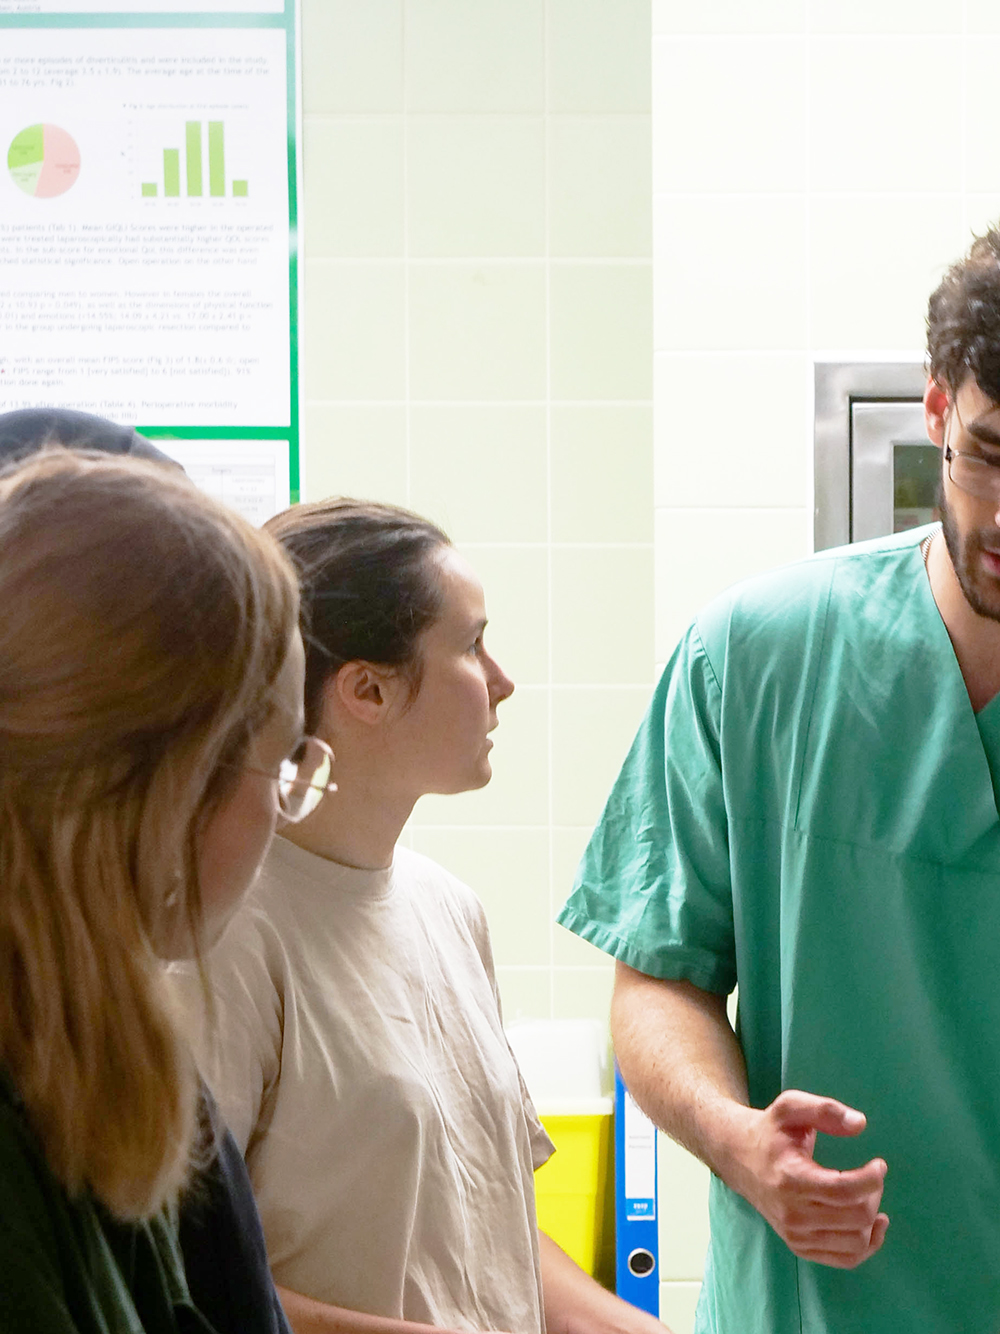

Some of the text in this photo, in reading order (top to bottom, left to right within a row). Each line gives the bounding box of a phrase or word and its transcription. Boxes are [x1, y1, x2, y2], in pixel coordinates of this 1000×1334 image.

[38, 56, 72, 65] episodes
[86, 56, 138, 64] diverticulitis
[140, 56, 156, 64] and
[180, 56, 216, 64] included
[228, 56, 242, 64] the
[244, 56, 268, 65] study.
[43, 67, 79, 76] (average
[127, 67, 142, 75] The
[144, 68, 177, 76] average
[179, 68, 194, 76] age
[207, 67, 221, 75] the
[223, 67, 243, 75] time
[255, 67, 270, 75] the
[12, 224, 45, 232] patients
[48, 224, 65, 232] (Tab
[181, 224, 207, 232] higher
[236, 224, 274, 232] operated
[24, 235, 55, 243] treated
[57, 235, 122, 244] laparoscopically
[125, 235, 140, 243] had
[143, 235, 194, 244] substantially
[196, 235, 222, 244] higher
[25, 246, 40, 254] the
[98, 246, 139, 254] emotional
[159, 246, 174, 254] this
[177, 246, 219, 254] difference
[21, 257, 61, 265] statistical
[118, 257, 140, 266] Open
[142, 257, 182, 266] operation
[196, 257, 210, 265] the
[212, 257, 234, 265] other
[237, 257, 257, 265] hand
[13, 290, 56, 299] comparing
[124, 290, 159, 298] However
[173, 290, 205, 298] females
[207, 290, 221, 298] the
[223, 290, 252, 298] overall
[98, 301, 115, 309] well
[129, 301, 142, 309] the
[145, 301, 190, 309] dimensions
[203, 301, 236, 310] physical
[238, 301, 273, 309] function
[20, 312, 36, 320] and
[38, 312, 76, 320] emotions
[15, 323, 29, 331] the
[31, 324, 55, 332] group
[57, 323, 102, 332] undergoing
[104, 323, 155, 332] laparoscopic
[158, 323, 196, 331] resection
[198, 323, 239, 332] compared
[14, 356, 33, 364] with
[47, 356, 75, 364] overall
[147, 356, 162, 365] (Fig
[239, 357, 259, 365] open
[32, 368, 56, 376] range
[58, 367, 77, 375] from
[86, 367, 108, 376] [very
[110, 367, 148, 376] satisfied]
[170, 367, 186, 376] [not
[0, 378, 16, 386] tion
[18, 378, 38, 386] done
[35, 400, 54, 408] after
[58, 400, 97, 409] operation
[100, 400, 125, 409] (Table
[141, 400, 195, 409] Perioperative
[198, 400, 237, 409] morbidity
